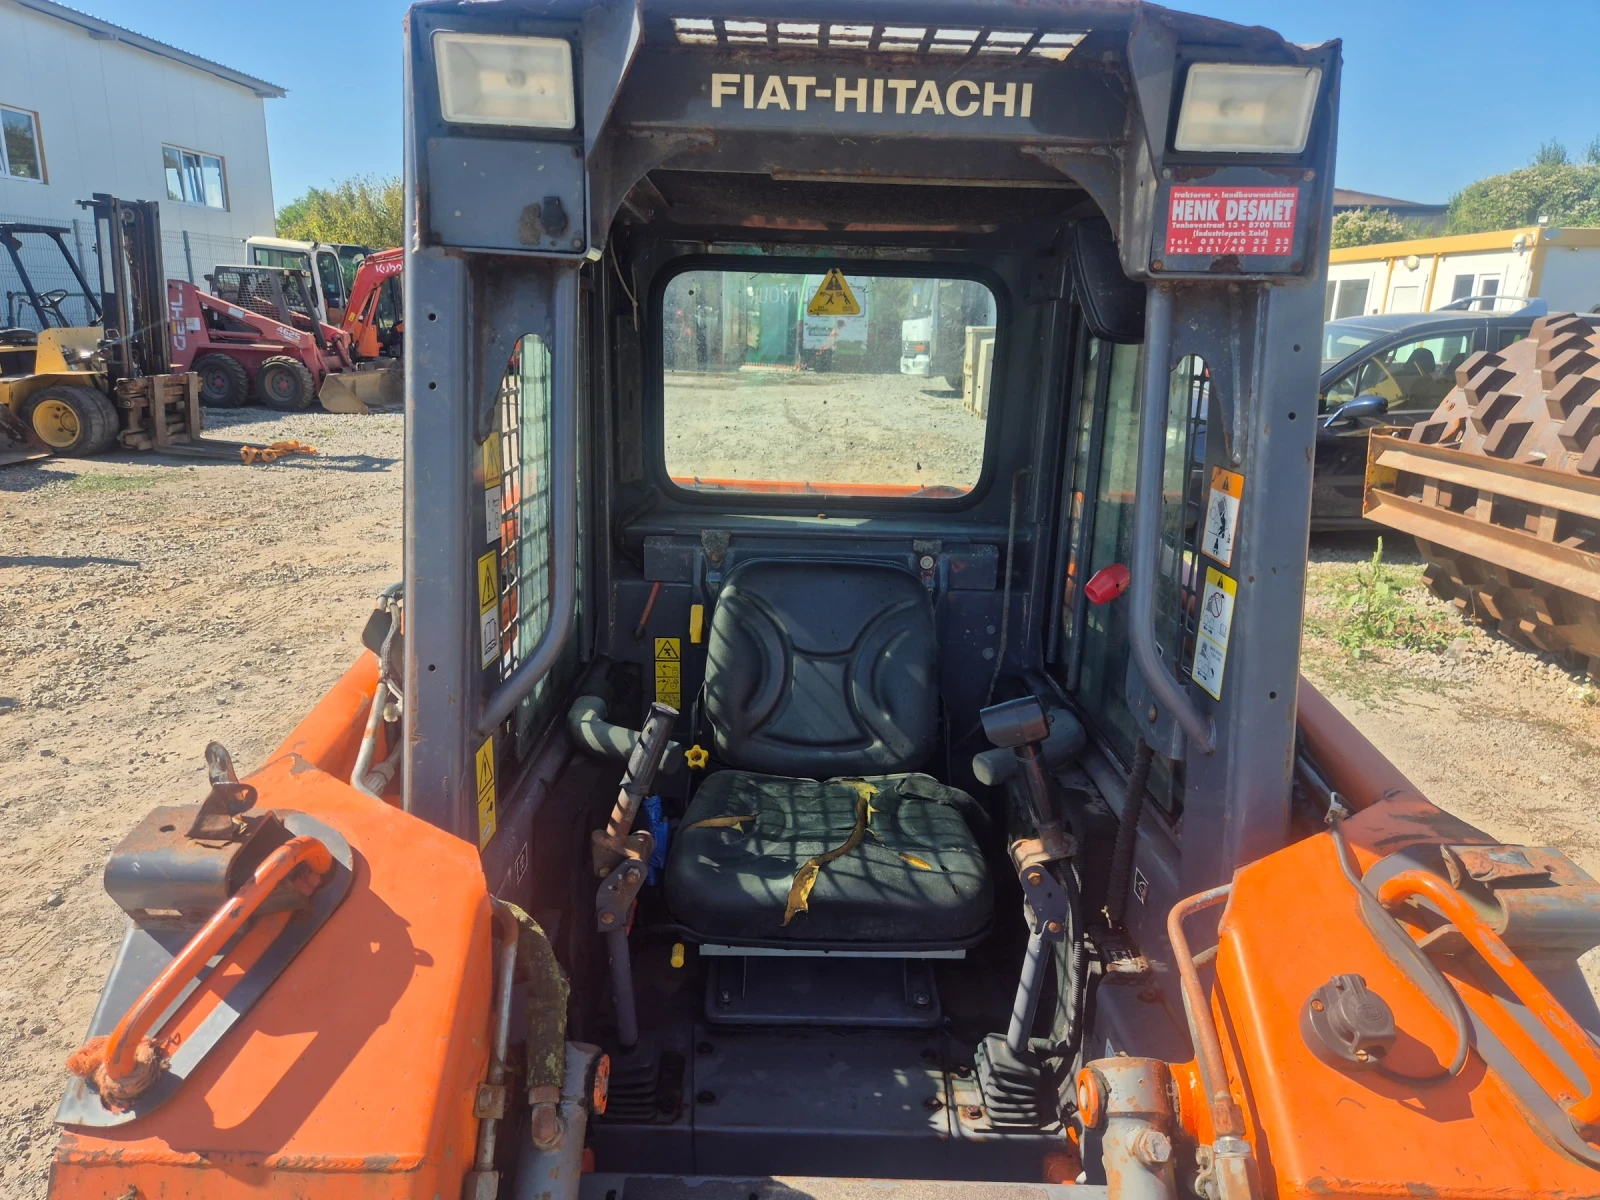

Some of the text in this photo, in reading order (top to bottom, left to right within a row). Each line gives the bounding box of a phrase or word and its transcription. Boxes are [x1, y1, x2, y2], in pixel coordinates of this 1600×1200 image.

[711, 72, 1033, 118] FIAT-HITACHI
[1174, 191, 1211, 199] traktoren
[1172, 199, 1294, 221] HENK DESMET
[1172, 221, 1292, 229] Tenhovestraat 13 8700 TIELT
[1171, 237, 1289, 246] Tel. 051/40 32 22
[1170, 245, 1288, 254] Fax 051/40 51 77
[276, 326, 301, 340] 4625
